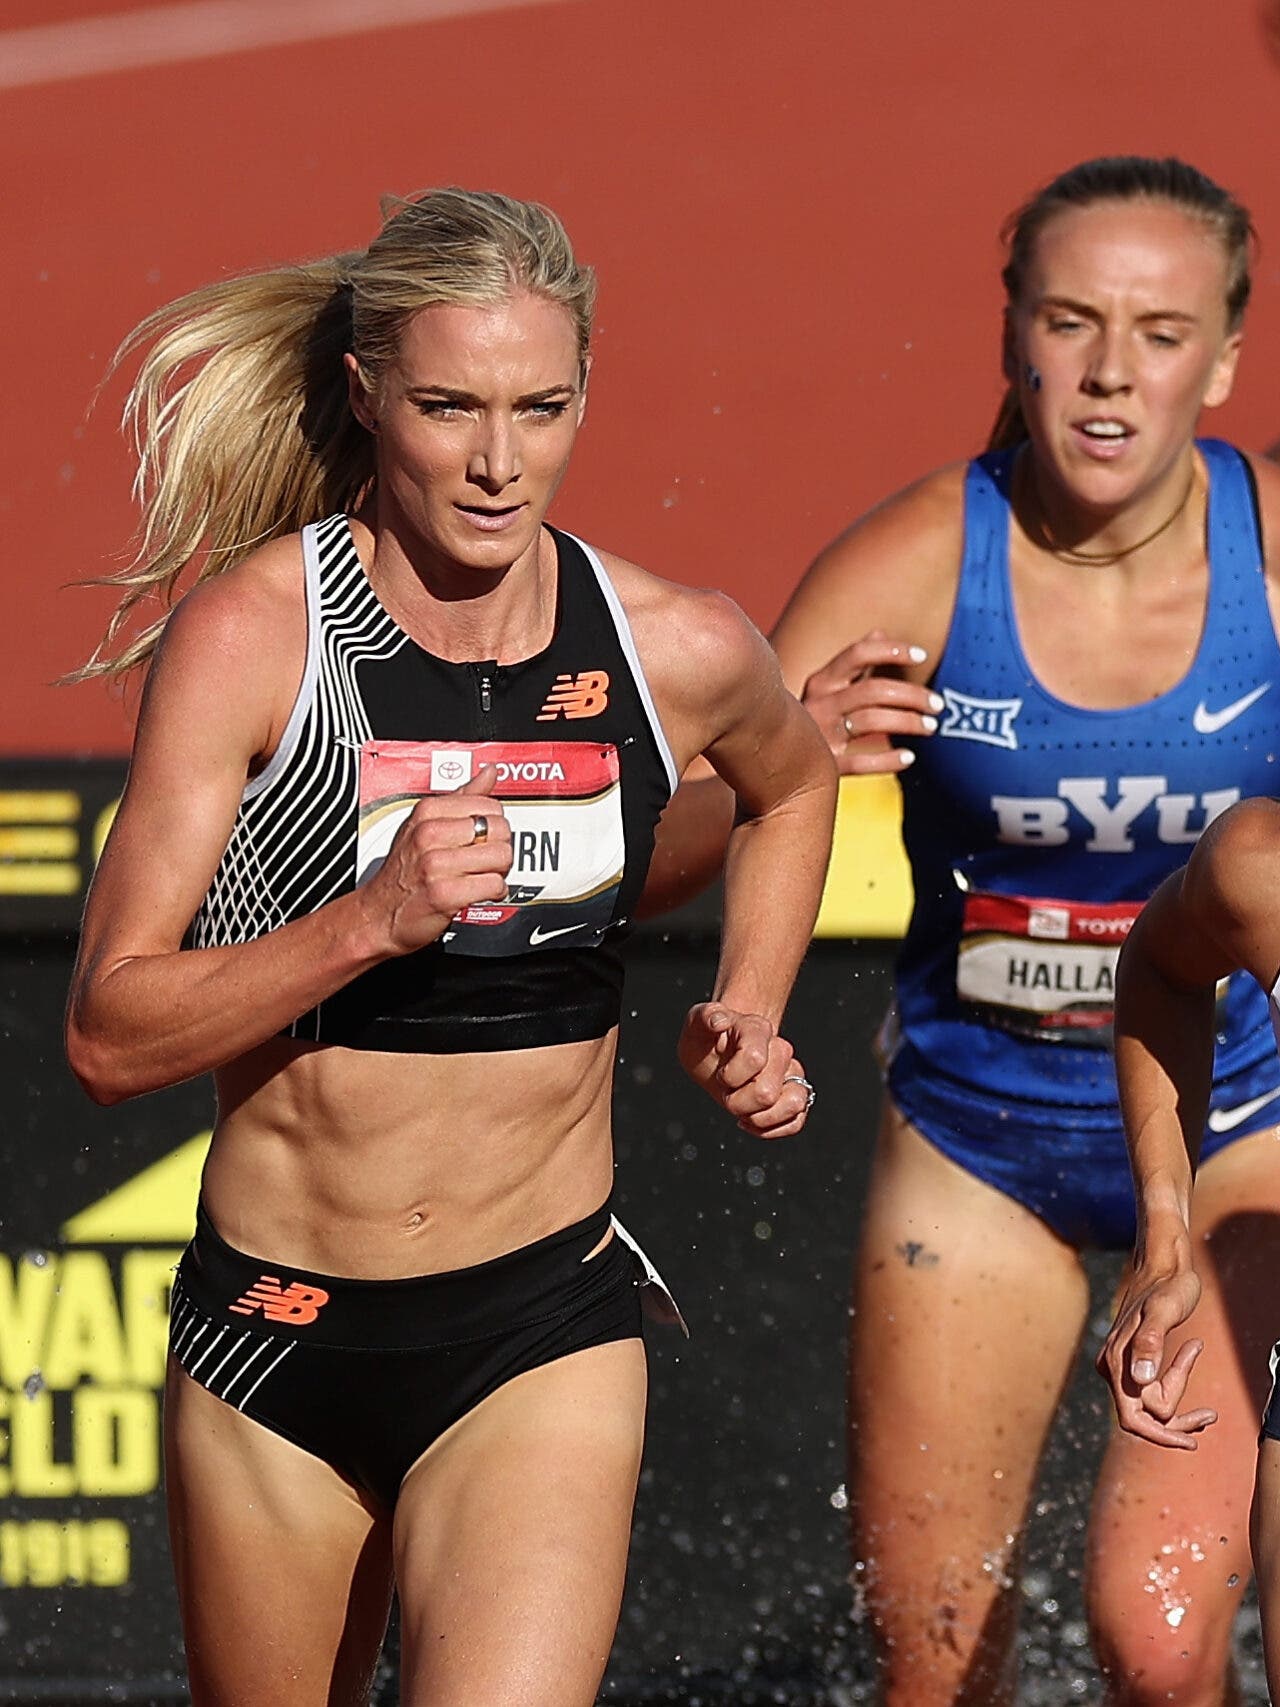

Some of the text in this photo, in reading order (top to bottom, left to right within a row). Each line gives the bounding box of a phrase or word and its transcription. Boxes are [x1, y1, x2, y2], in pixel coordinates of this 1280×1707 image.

[479, 762, 565, 781] OYOTA
[990, 776, 1240, 852] BYU
[511, 831, 560, 872] RN
[1009, 958, 1113, 991] HALLA
[0, 1388, 159, 1497] LD
